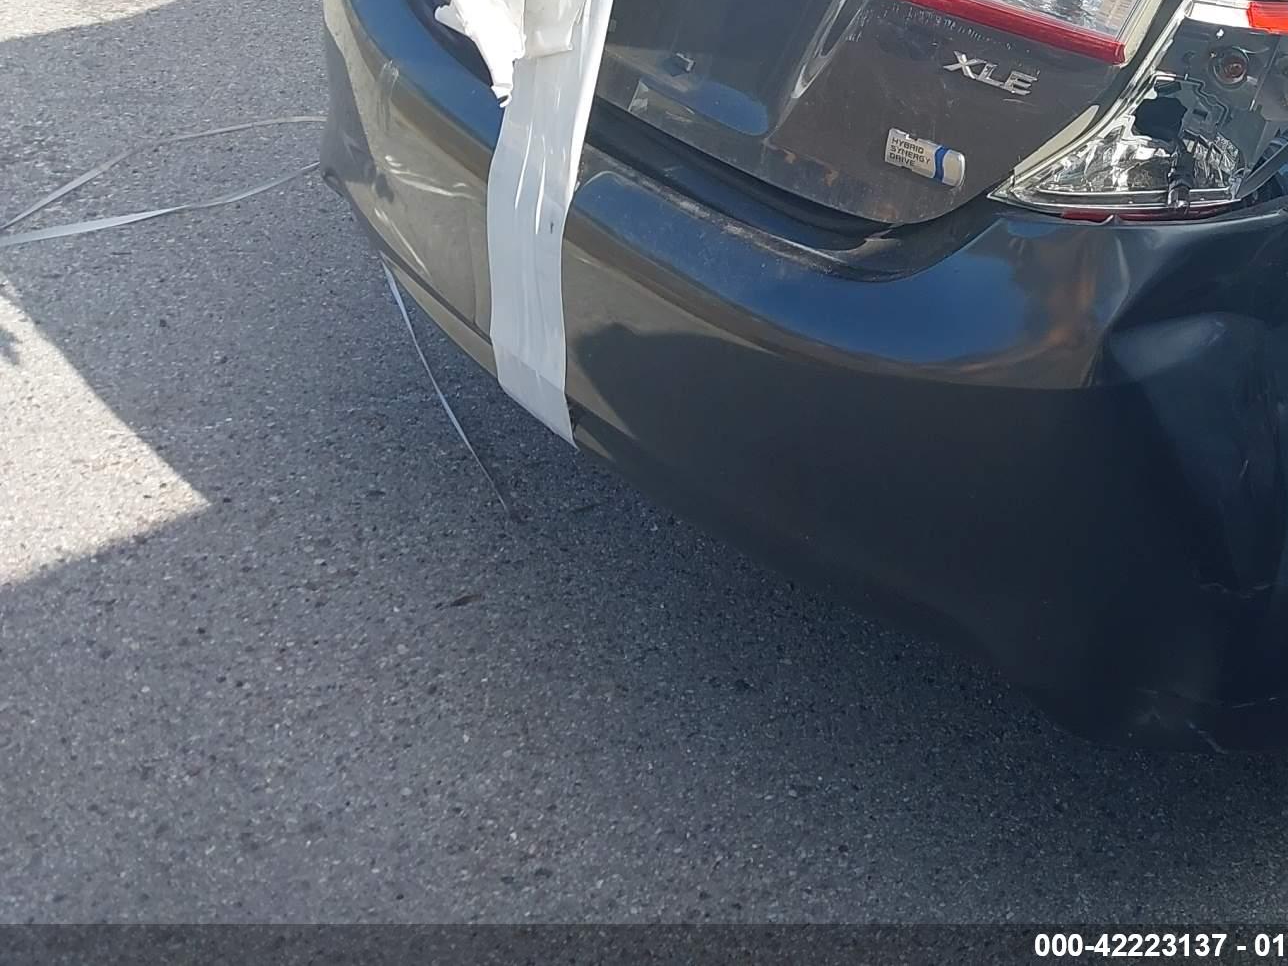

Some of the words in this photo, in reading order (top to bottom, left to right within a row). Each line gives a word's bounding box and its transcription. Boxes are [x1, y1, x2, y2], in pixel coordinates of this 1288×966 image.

[943, 50, 1038, 96] XLE
[890, 144, 931, 165] SYNERGY
[892, 137, 924, 154] HYBRID
[889, 152, 915, 166] DRIVE
